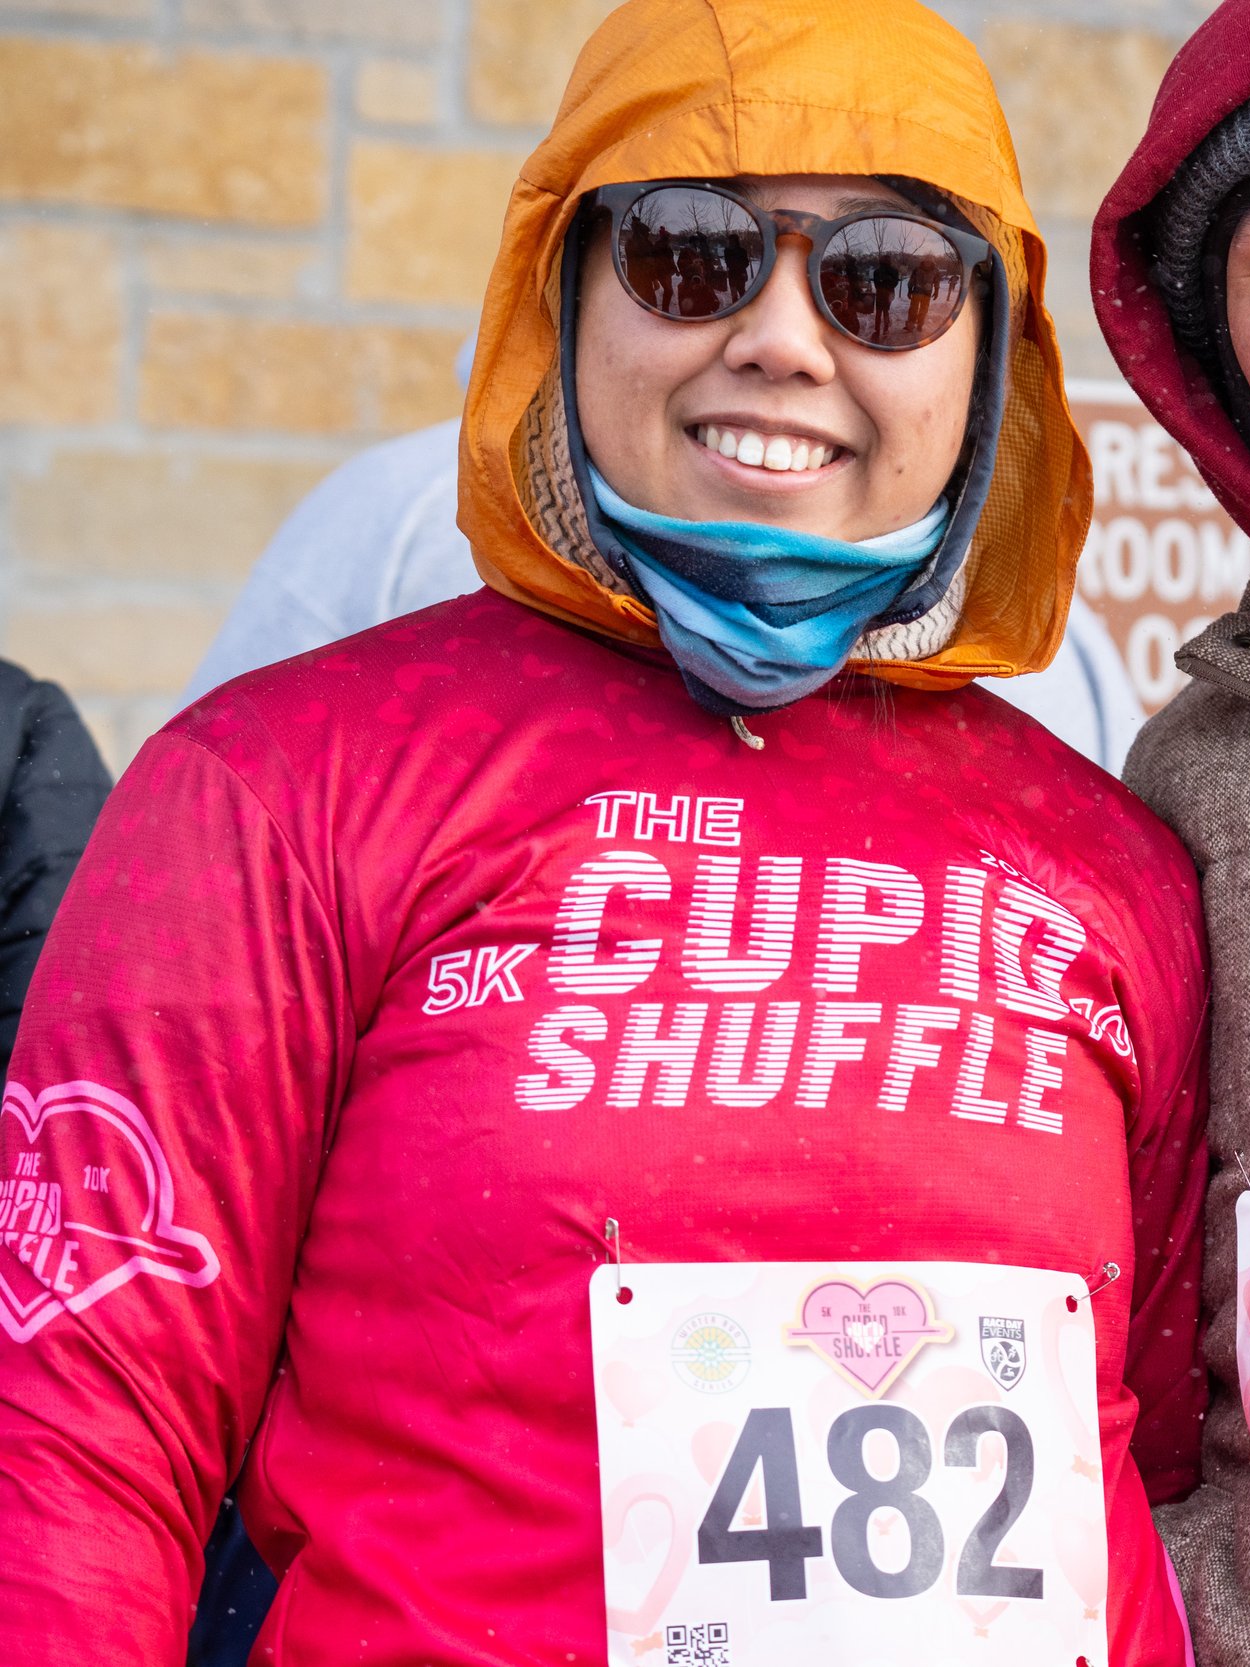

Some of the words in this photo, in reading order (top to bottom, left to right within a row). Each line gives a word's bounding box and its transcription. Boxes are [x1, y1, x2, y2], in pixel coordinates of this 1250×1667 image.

[1124, 613, 1214, 707] O
[585, 791, 743, 847] THE
[545, 850, 1087, 1021] CUPID
[421, 943, 541, 1016] 5K
[1069, 998, 1138, 1066] 10
[514, 1001, 1069, 1135] SHUFFLE
[15, 1152, 41, 1177] THE
[84, 1164, 110, 1194] 10K
[0, 1180, 62, 1236] UPID
[821, 1306, 832, 1318] 5K
[858, 1303, 871, 1313] THE
[982, 1327, 1022, 1339] EVENTS
[983, 1317, 1005, 1328] RACE
[1005, 1319, 1023, 1330] DAY
[833, 1336, 902, 1359] SHUFFLE
[697, 1404, 1044, 1602] 482
